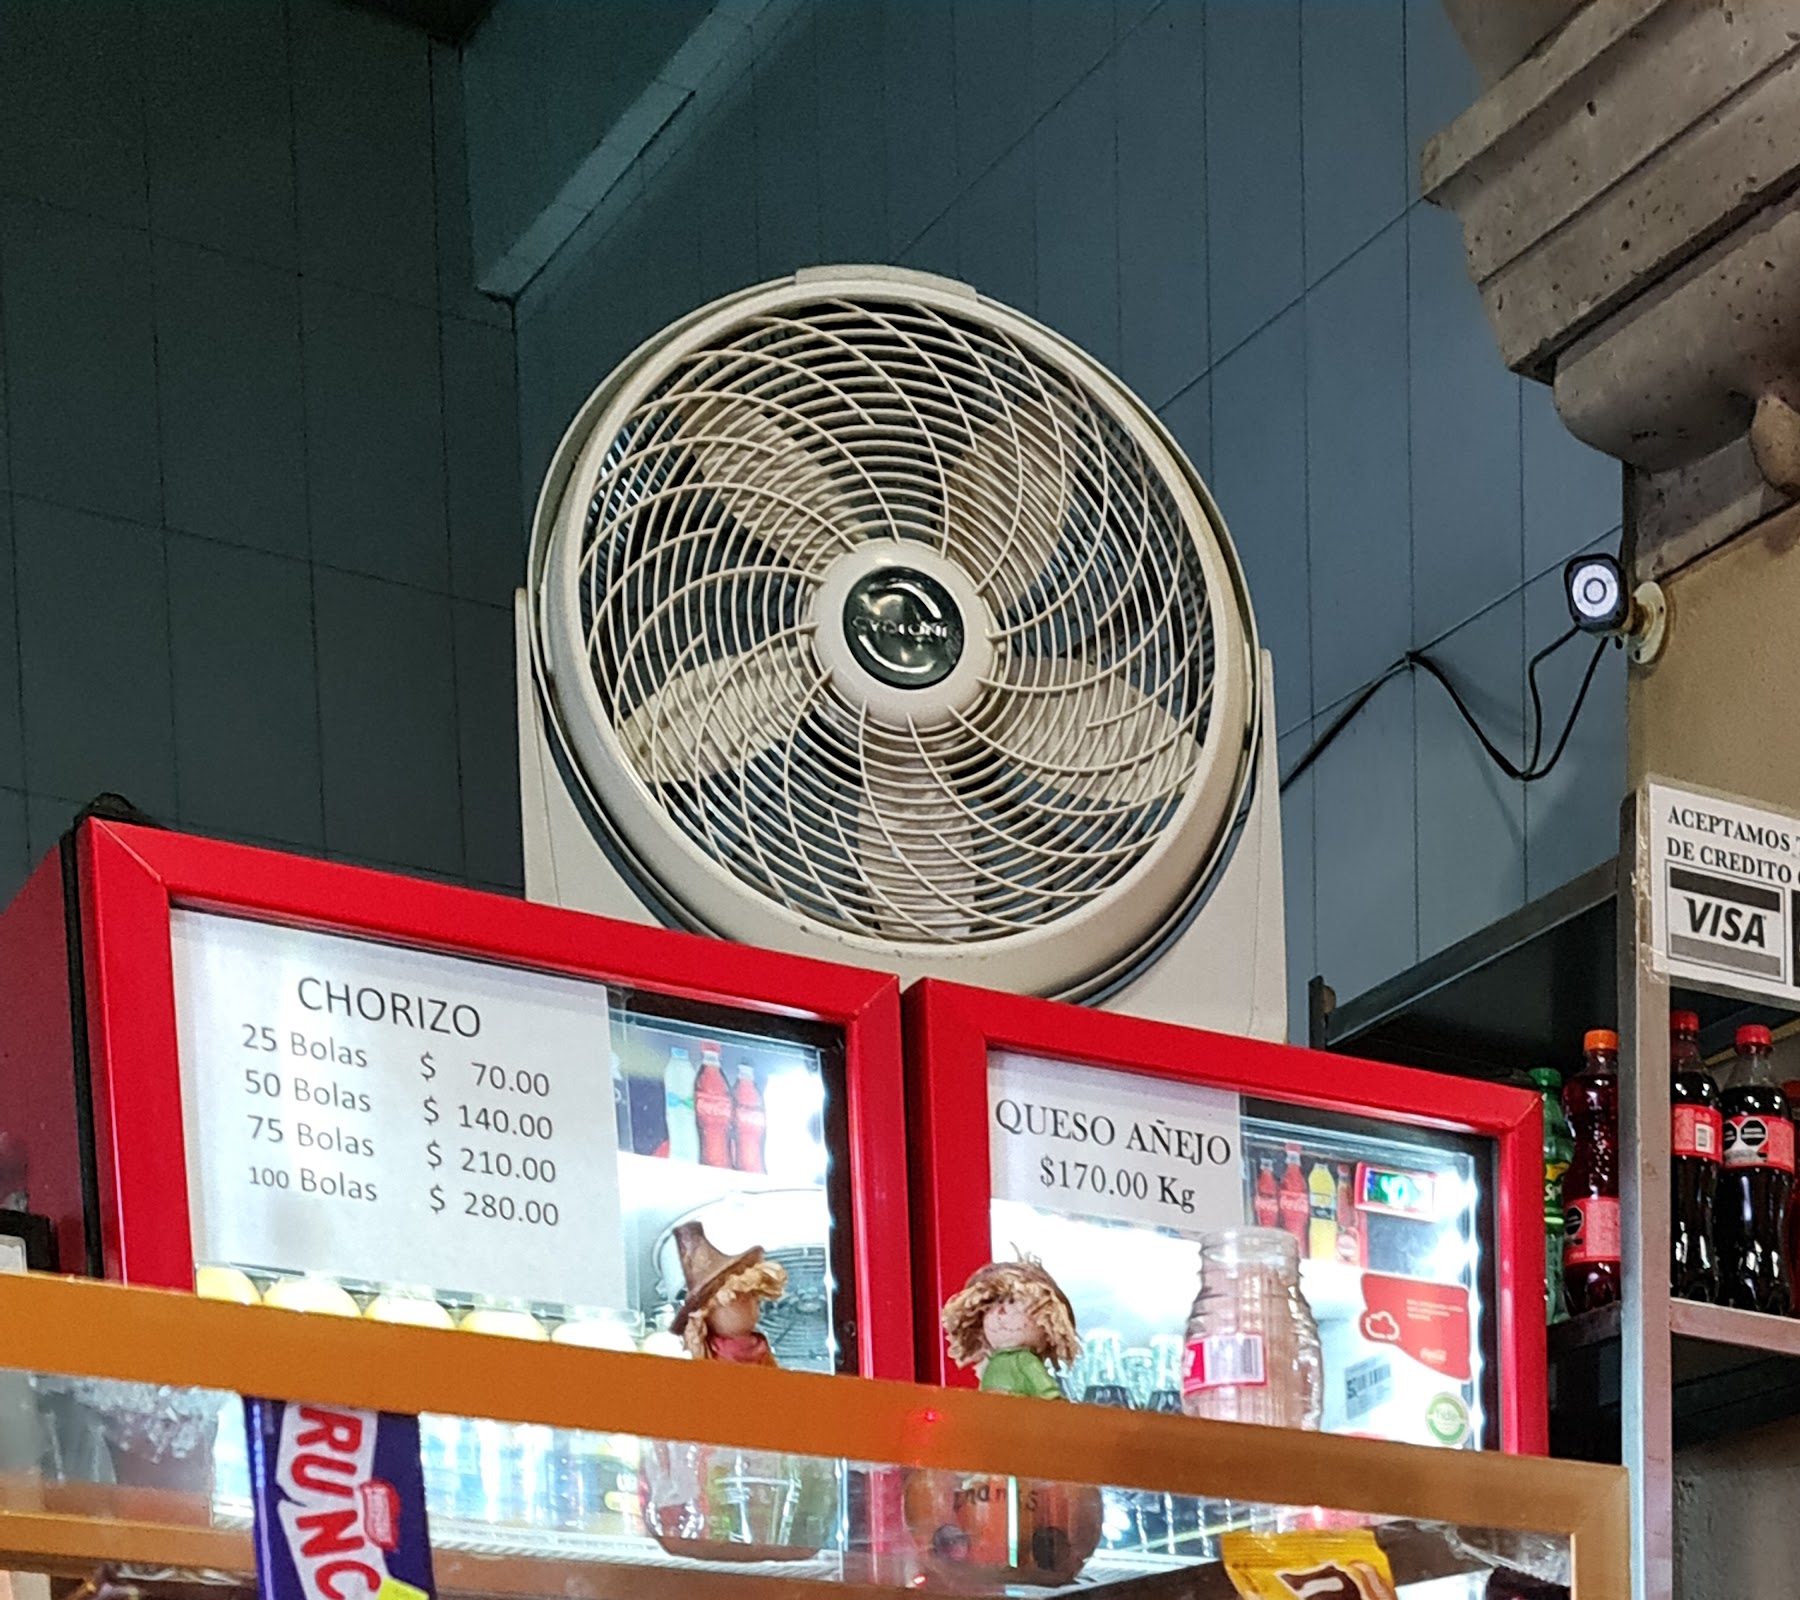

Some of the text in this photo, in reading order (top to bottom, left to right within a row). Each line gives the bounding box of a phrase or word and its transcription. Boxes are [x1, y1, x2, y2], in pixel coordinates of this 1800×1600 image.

[1667, 805, 1791, 852] ACEPTAMOS
[1667, 836, 1695, 860] DE
[1700, 844, 1793, 885] CREDITO
[1683, 895, 1768, 949] VISA
[297, 975, 482, 1040] CHORIZO
[240, 1022, 551, 1098] 25 Bolas $ 70.00
[244, 1068, 555, 1142] 50 Bolas $ 140.00
[995, 1098, 1232, 1168] QUESO AÑEJO
[246, 1113, 557, 1186] 75 Bolas $ 210.00
[247, 1164, 560, 1229] 100 Bolas $ 280.00
[1039, 1155, 1196, 1214] $170.00 Kg
